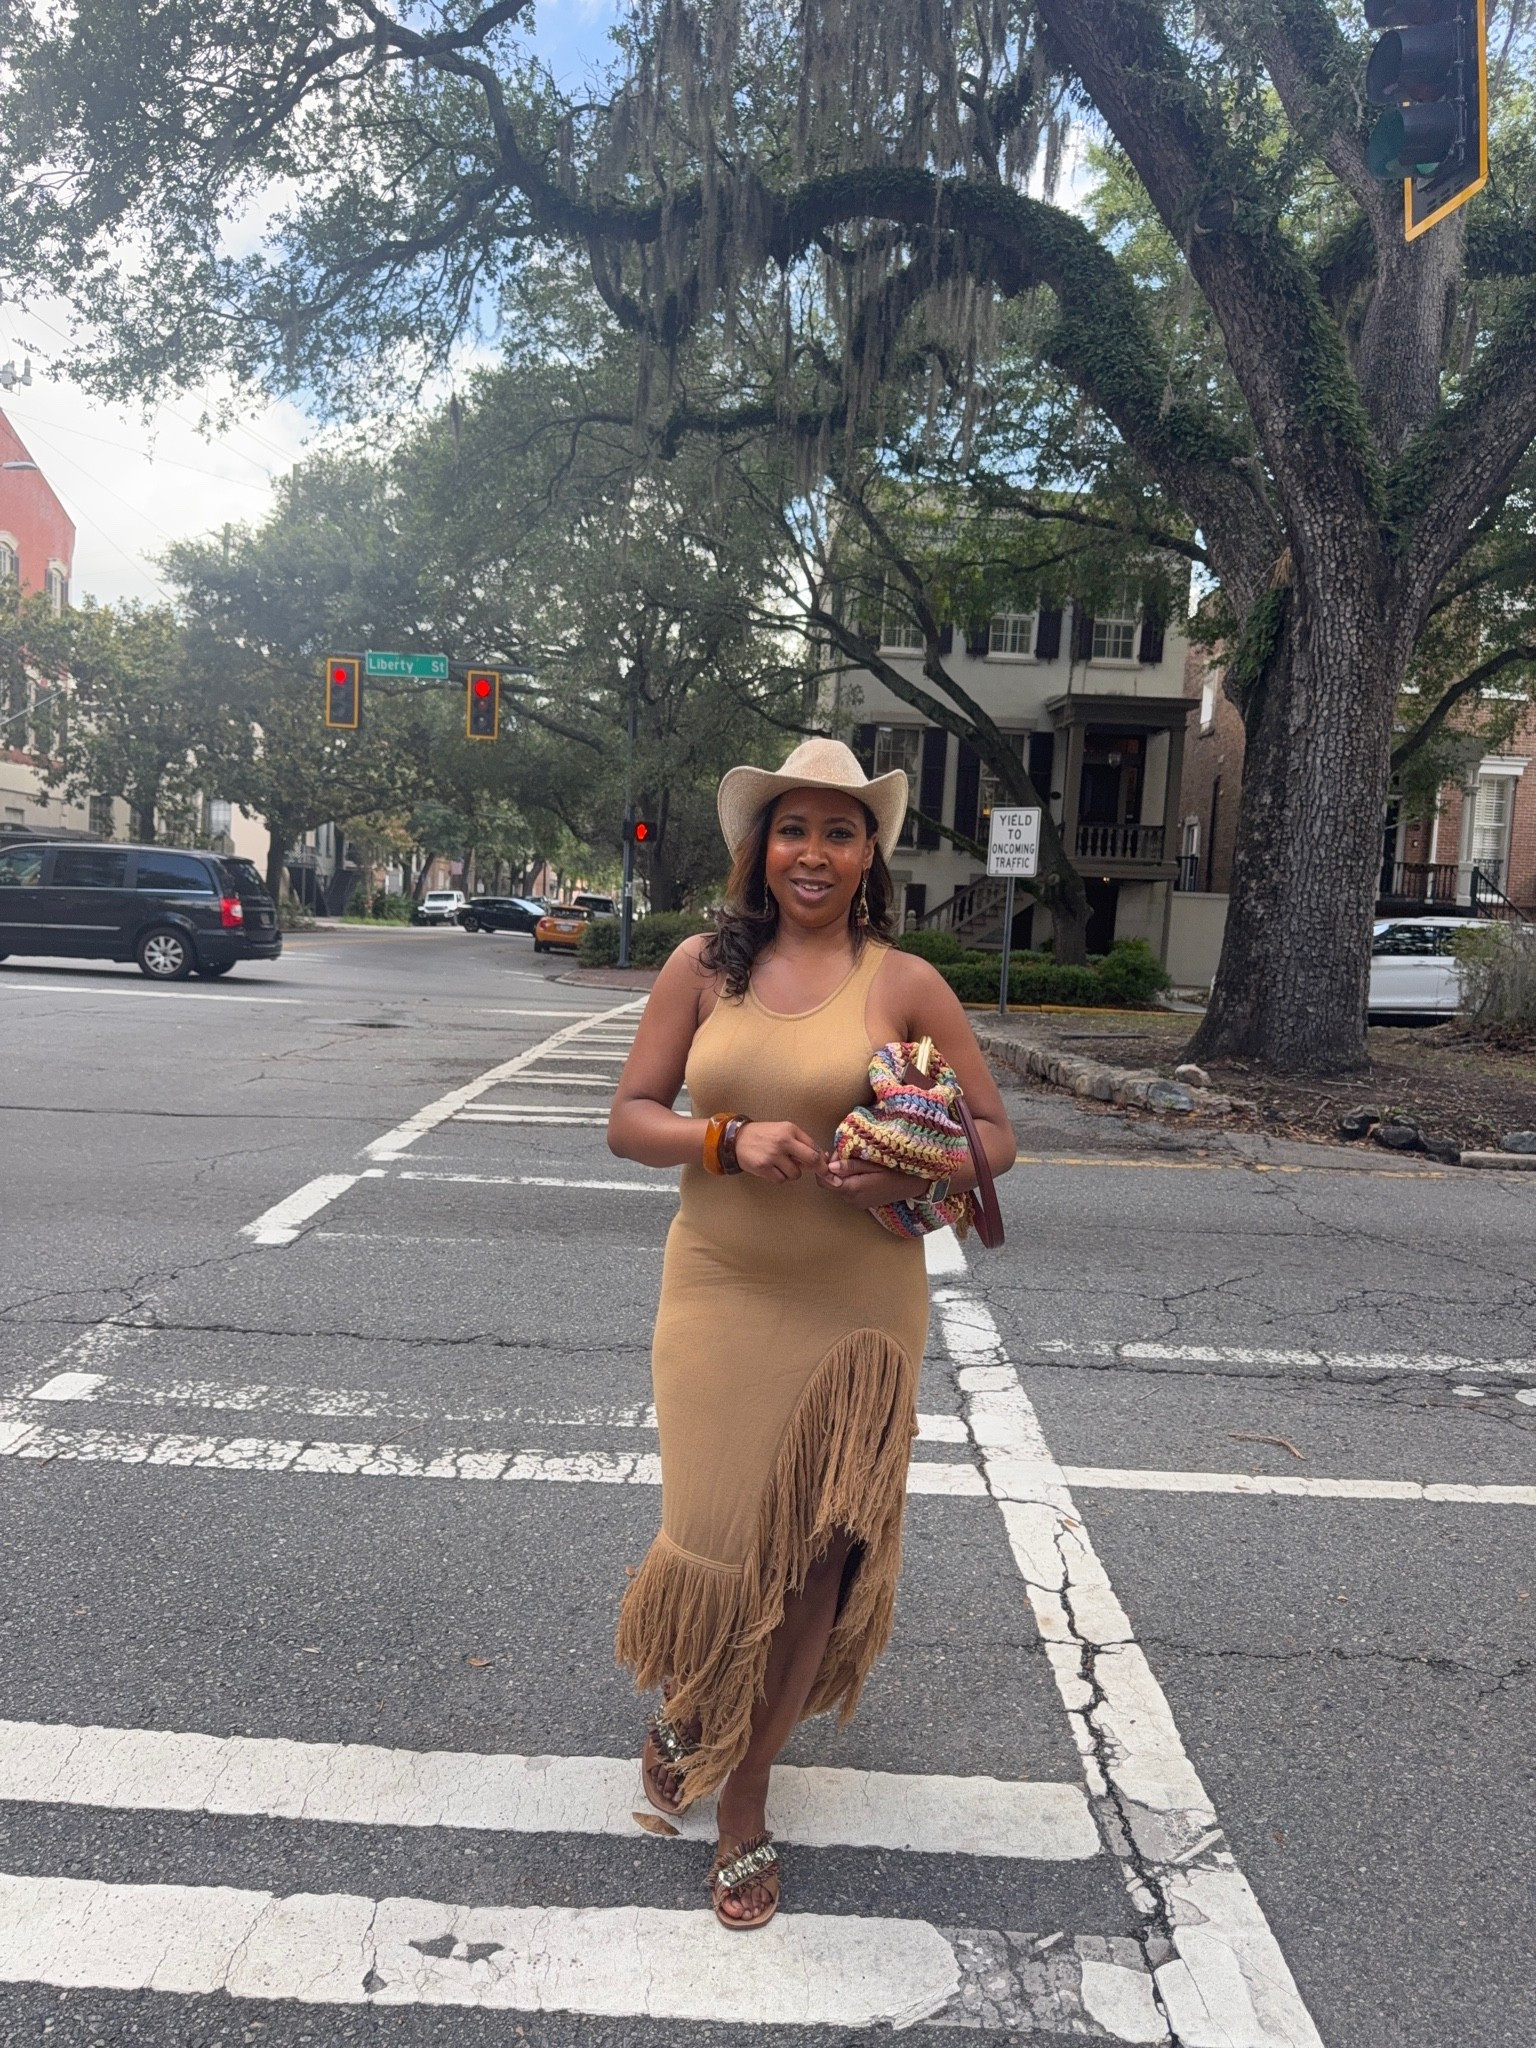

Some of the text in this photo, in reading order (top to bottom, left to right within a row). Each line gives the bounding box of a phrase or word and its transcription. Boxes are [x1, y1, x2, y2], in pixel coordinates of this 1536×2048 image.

[369, 658, 445, 674] Liberty St
[1000, 814, 1032, 826] YIELD
[1008, 828, 1022, 840] TO
[992, 843, 1035, 855] ONCOMING
[995, 857, 1030, 869] TRAFFIC
